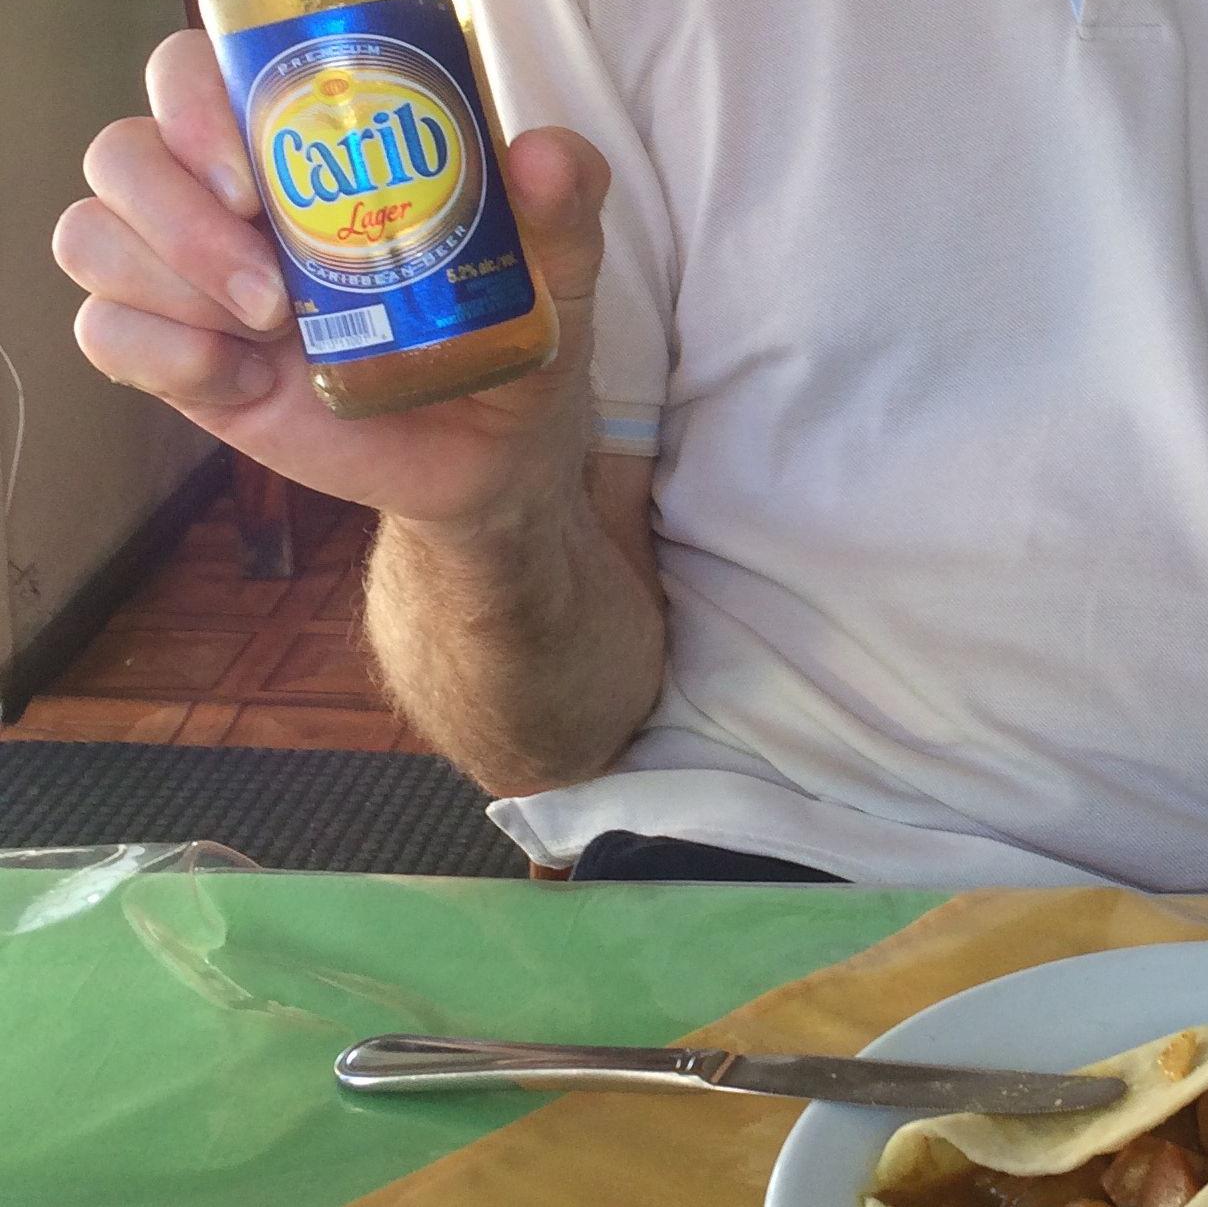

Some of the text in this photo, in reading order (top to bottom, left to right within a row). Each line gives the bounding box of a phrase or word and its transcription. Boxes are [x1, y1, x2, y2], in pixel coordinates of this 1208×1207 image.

[272, 102, 449, 210] Carib
[337, 200, 412, 242] Lager
[306, 226, 467, 286] CARIBBEAN BEER
